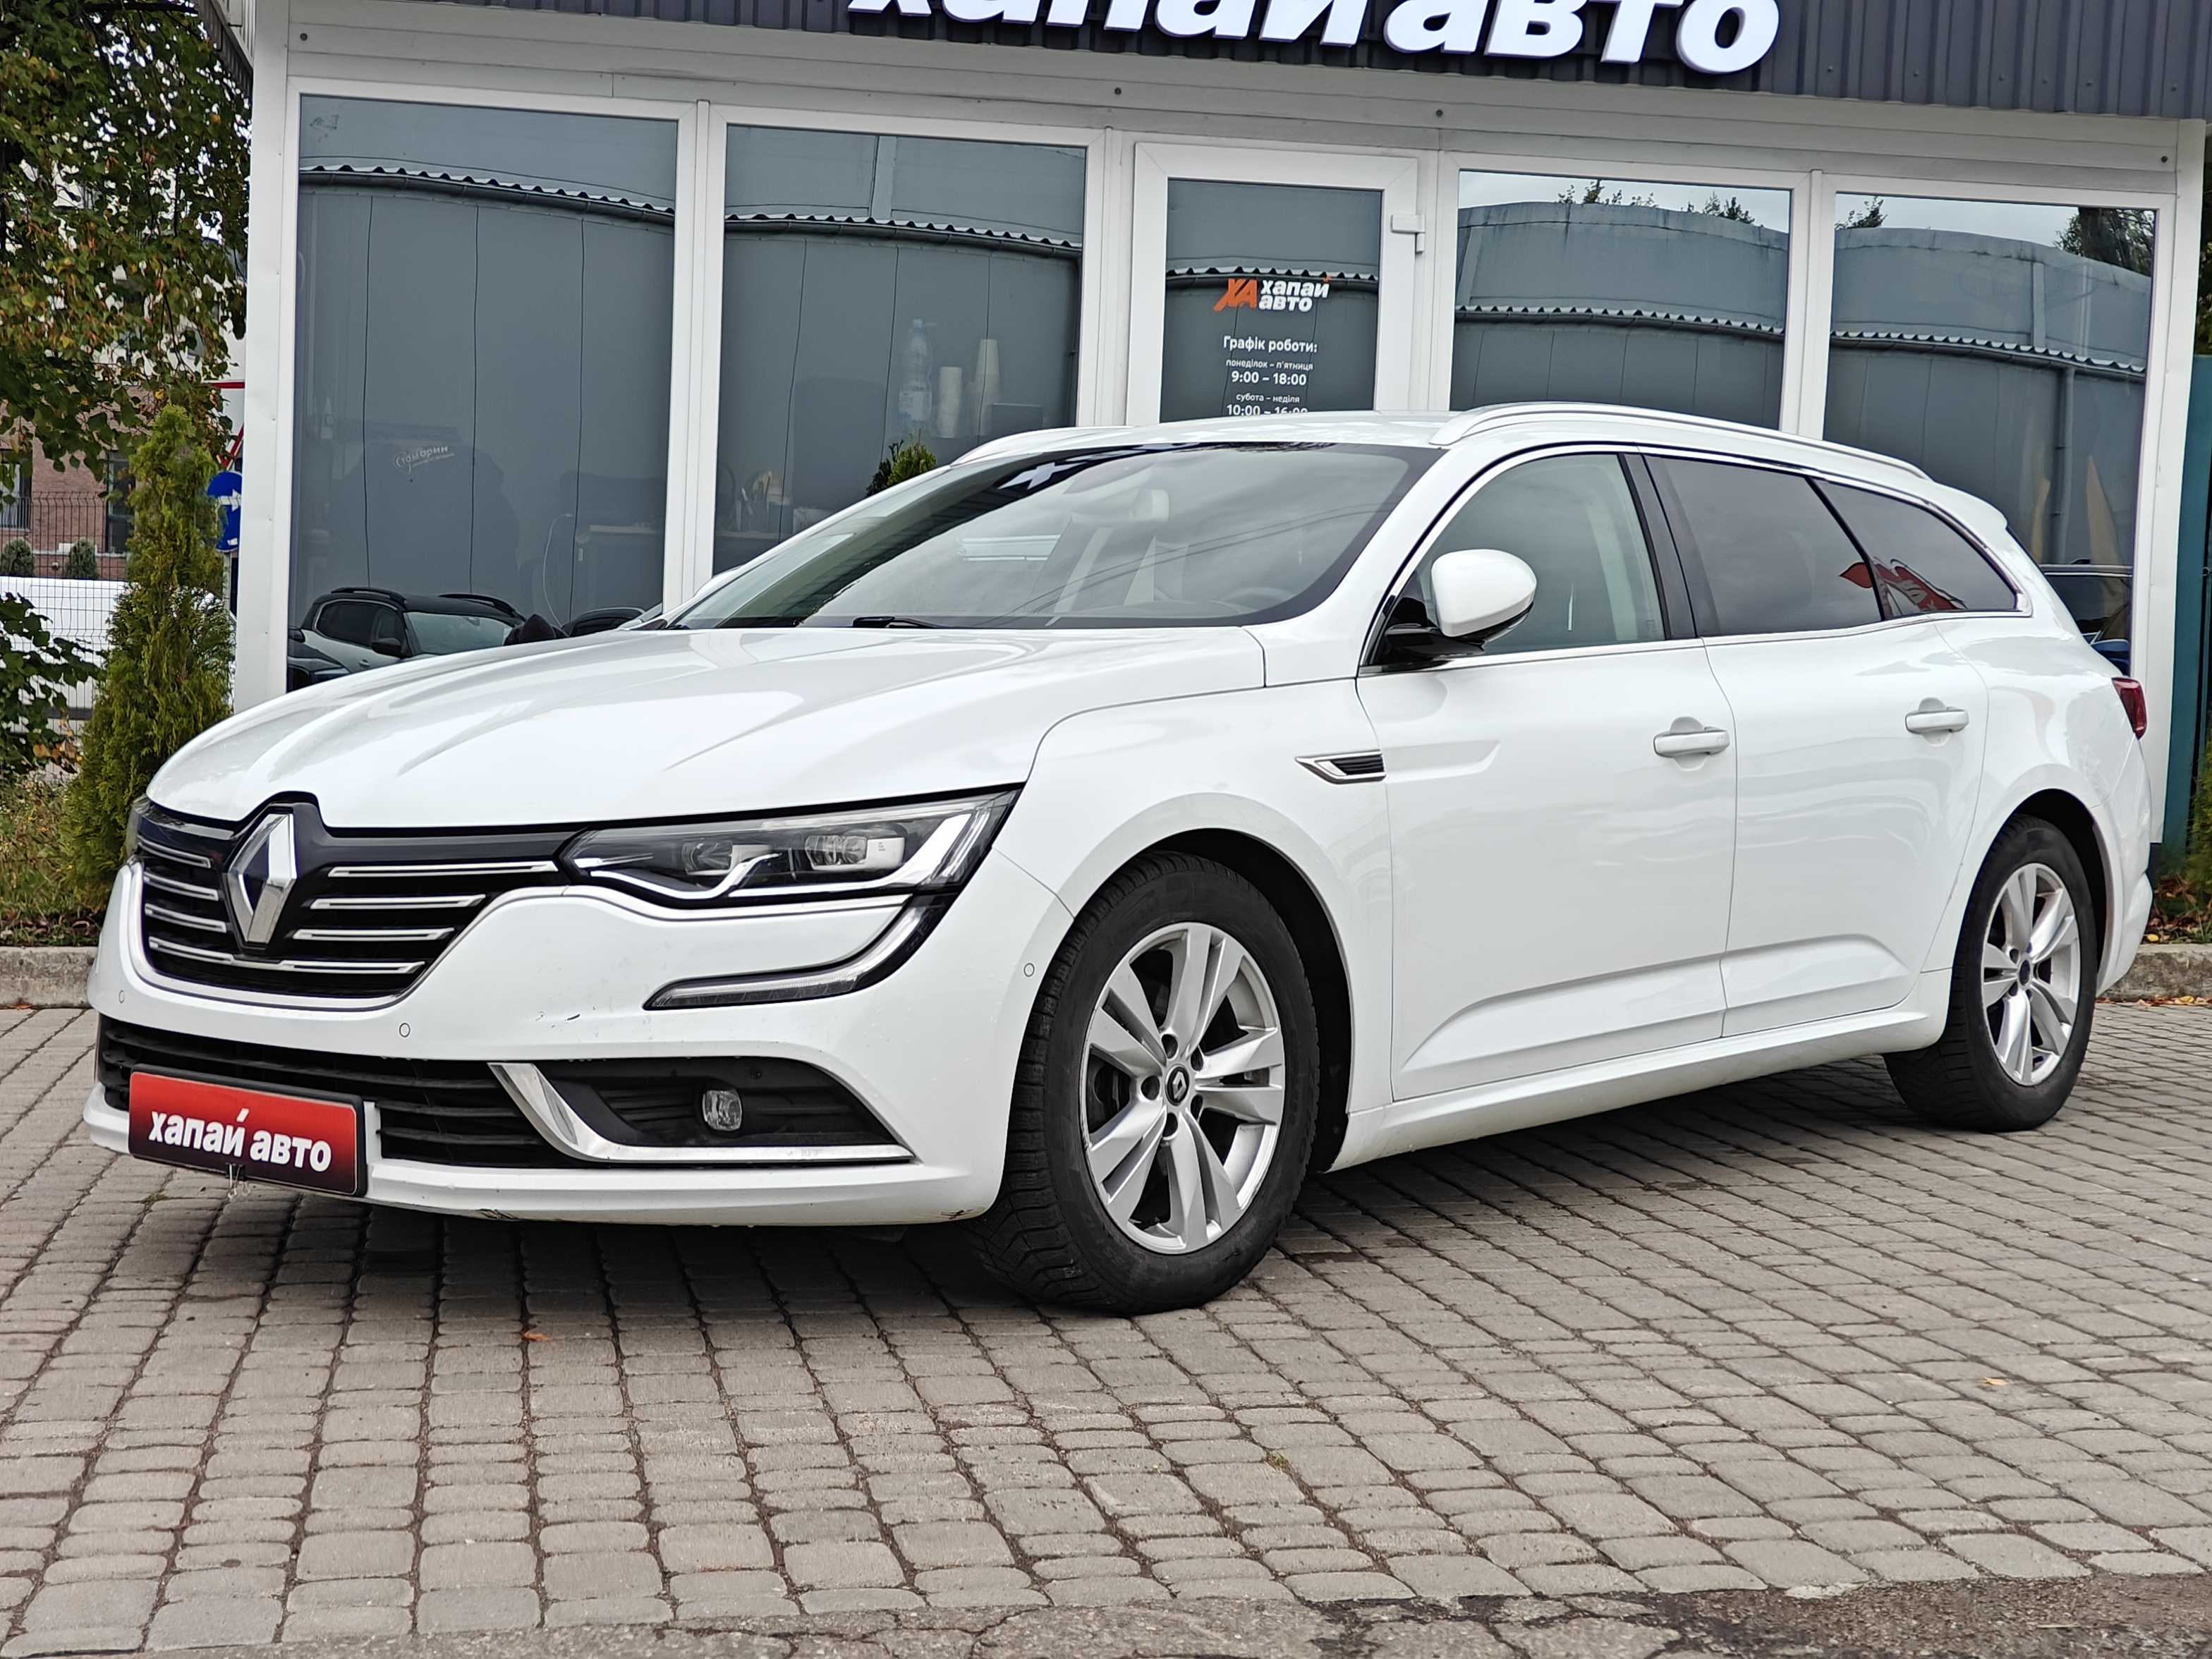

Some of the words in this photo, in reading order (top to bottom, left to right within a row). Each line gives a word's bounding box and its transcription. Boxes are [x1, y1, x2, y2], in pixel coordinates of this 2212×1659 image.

[1383, 0, 1780, 73] авто
[1258, 295, 1313, 312] авто
[1223, 335, 1265, 352] Графік
[1268, 339, 1318, 353] роботи:
[1226, 359, 1268, 368] понеділок
[1276, 360, 1313, 371] п'ятниця
[1232, 370, 1259, 383] 9:00
[1272, 372, 1307, 386] 18:00
[1236, 393, 1264, 402] субота
[1272, 395, 1300, 403] неділя
[1227, 404, 1260, 415] 10:00
[250, 1130, 332, 1172] авто
